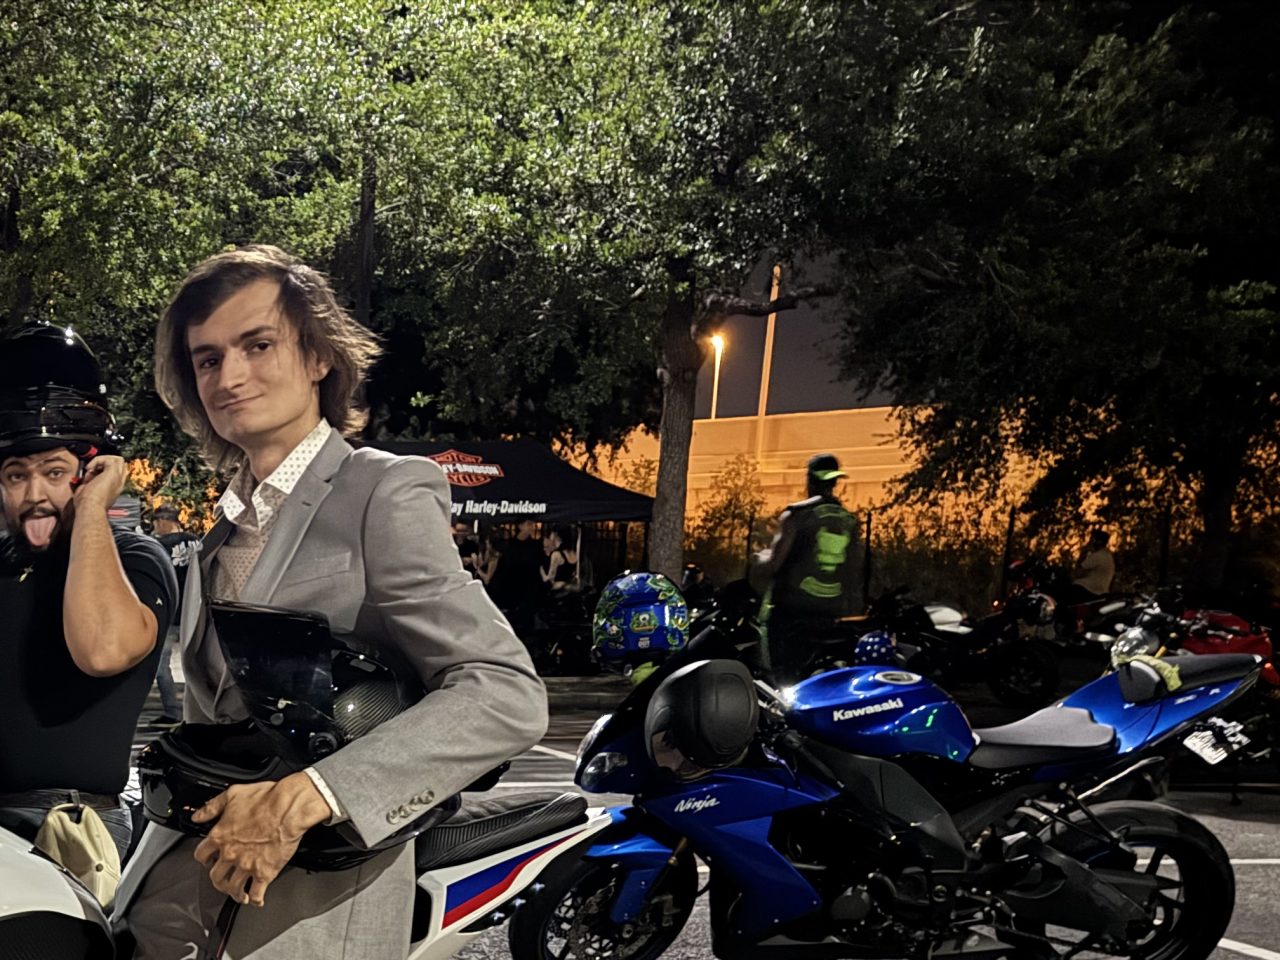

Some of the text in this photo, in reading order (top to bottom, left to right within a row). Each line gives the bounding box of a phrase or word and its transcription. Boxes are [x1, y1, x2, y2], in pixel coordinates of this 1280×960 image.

[442, 464, 500, 475] EY-DAVIDSON
[465, 500, 547, 516] Harley-Davidson
[833, 697, 905, 722] Kawasaki
[674, 795, 720, 814] Ninja
